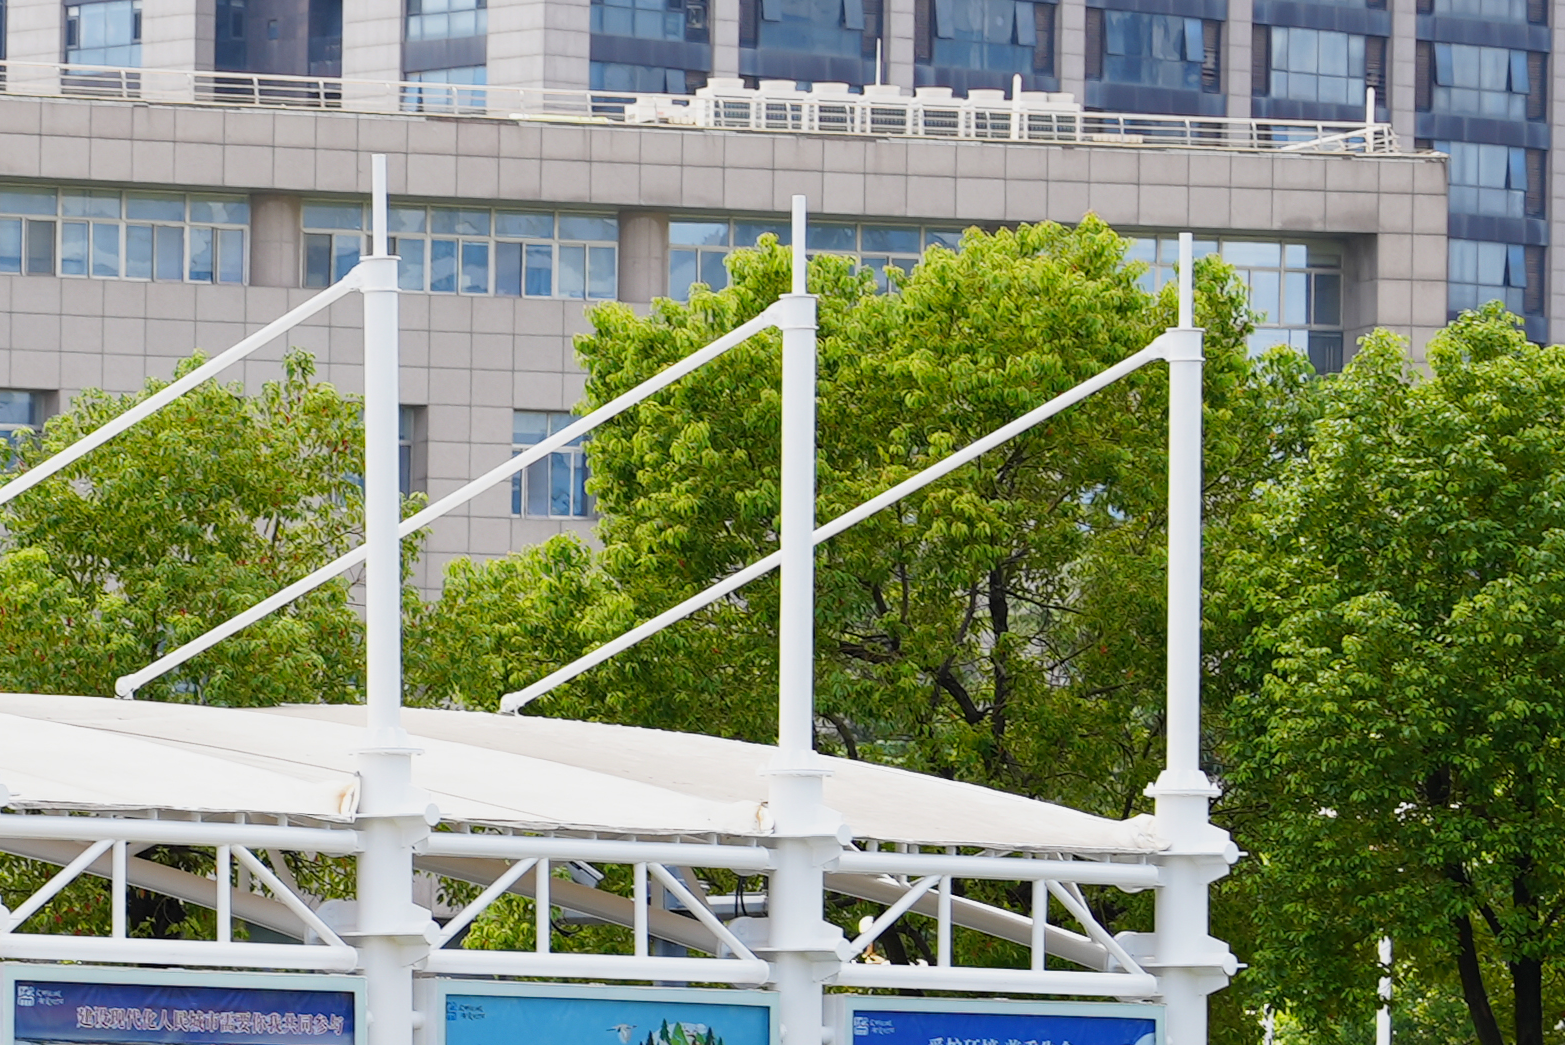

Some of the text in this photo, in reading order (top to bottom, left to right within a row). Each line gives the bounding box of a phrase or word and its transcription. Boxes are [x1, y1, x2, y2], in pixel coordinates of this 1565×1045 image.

[76, 1006, 344, 1036] 建设现代化人民城市需要你我共同参与
